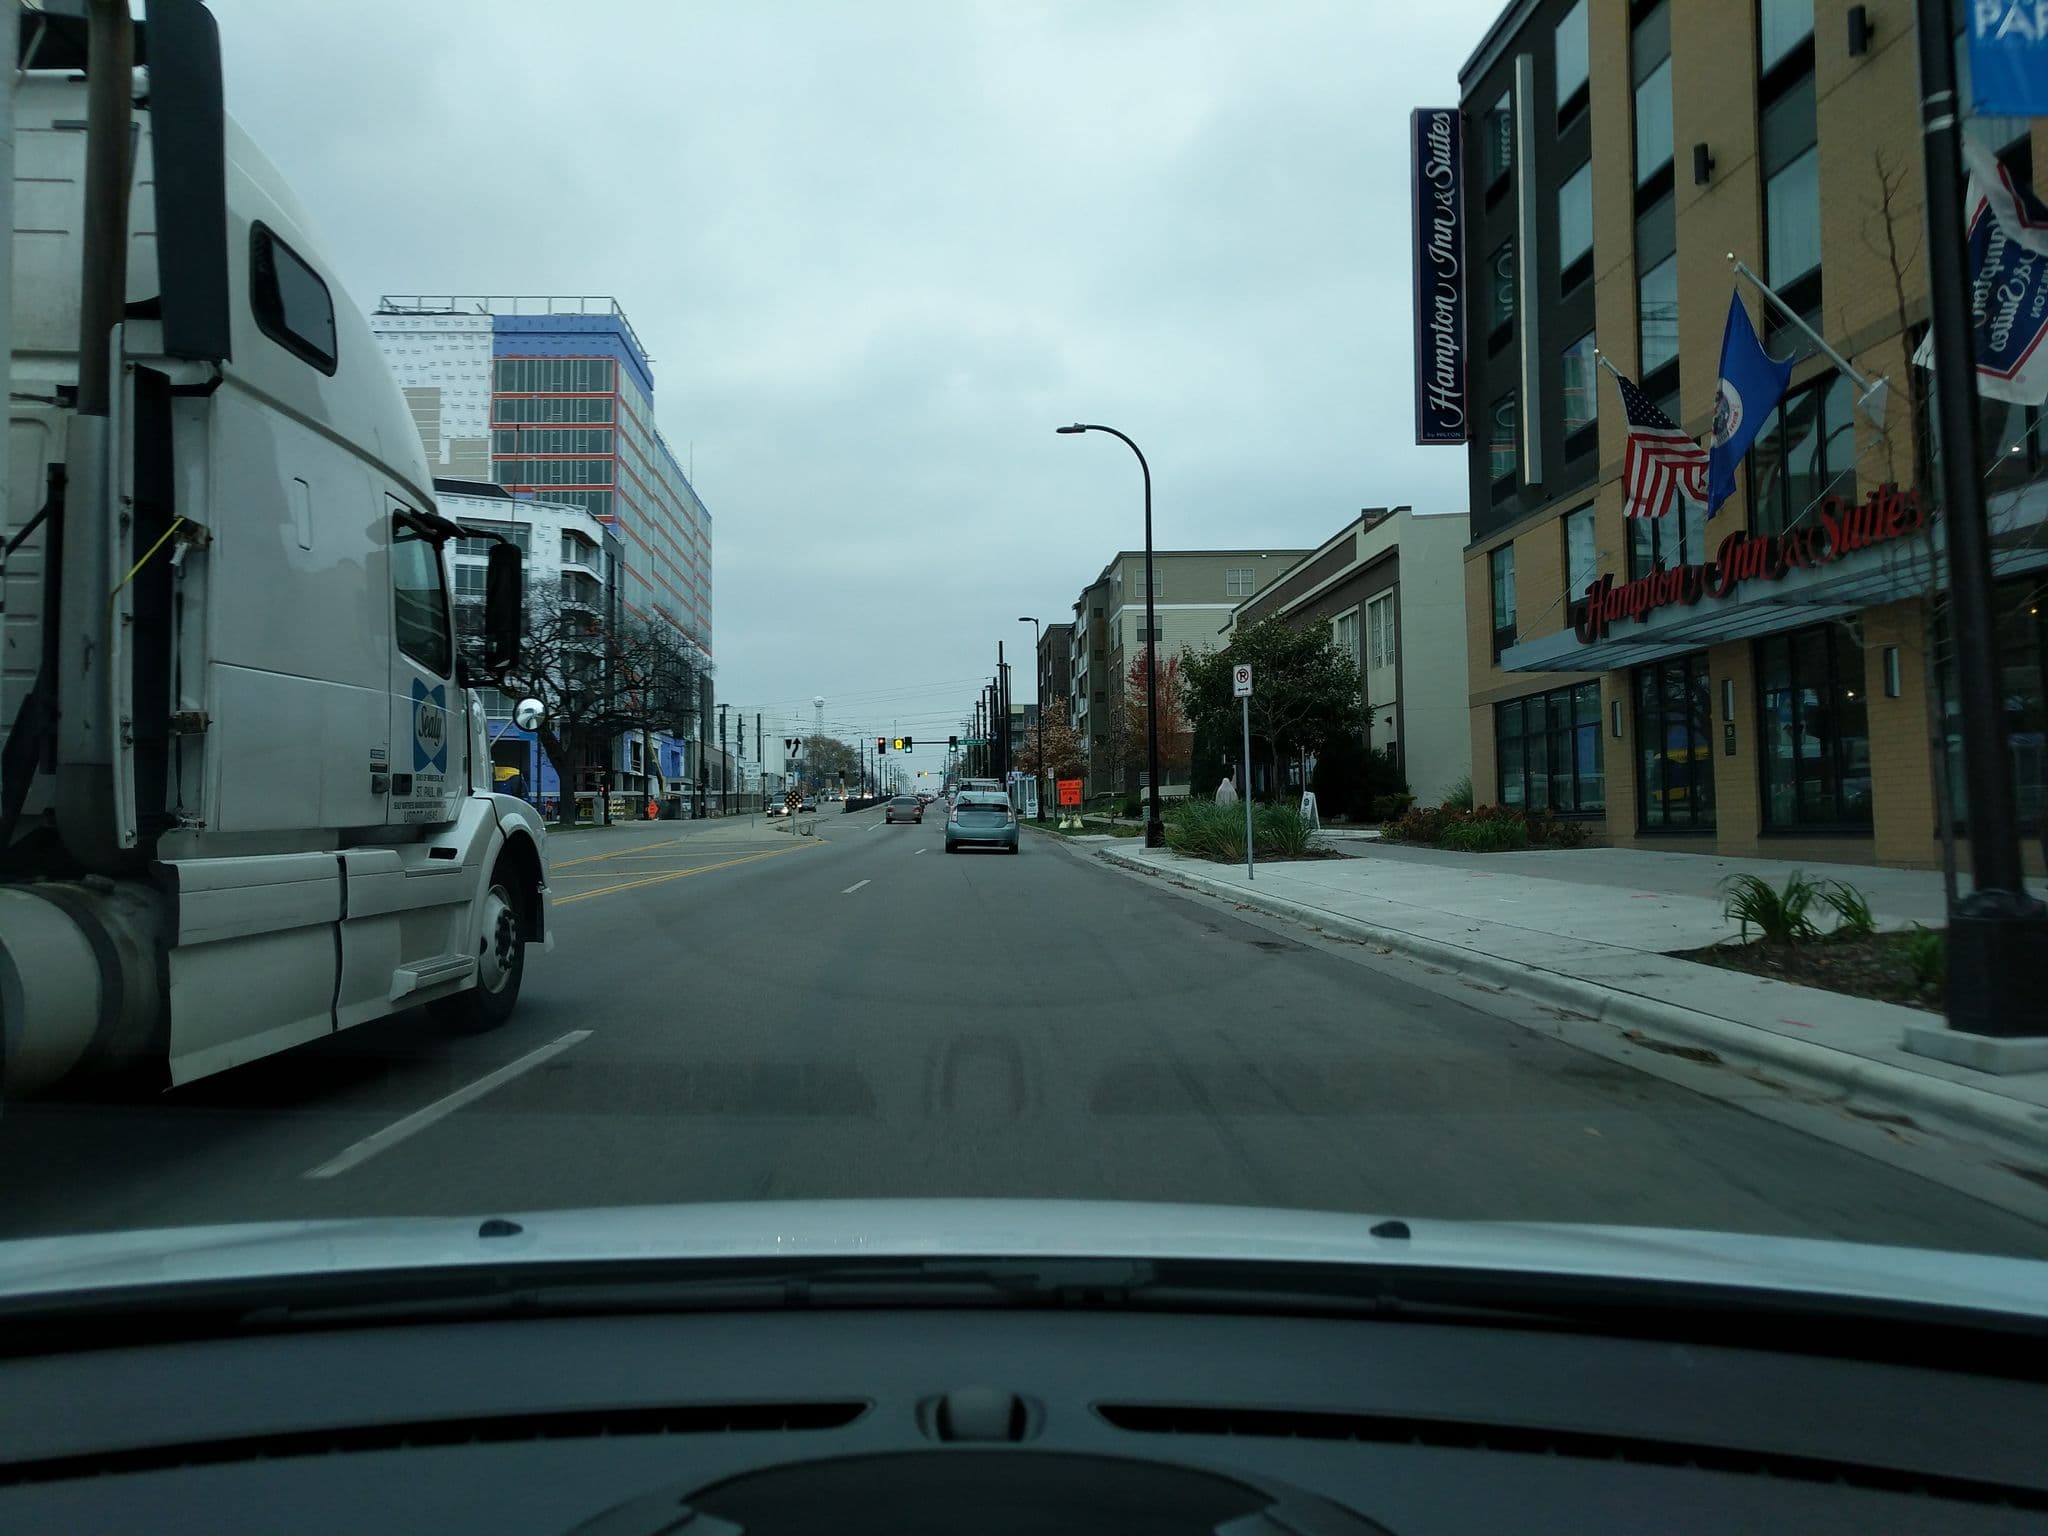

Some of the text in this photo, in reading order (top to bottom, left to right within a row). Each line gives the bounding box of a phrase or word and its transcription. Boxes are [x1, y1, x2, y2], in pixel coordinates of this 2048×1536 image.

[1425, 111, 1464, 428] Hampton Inn & Suites
[1574, 562, 1699, 644] Hampton
[1702, 531, 1785, 599] Inn
[1807, 484, 1925, 565] Suites
[418, 705, 442, 747] Sealy
